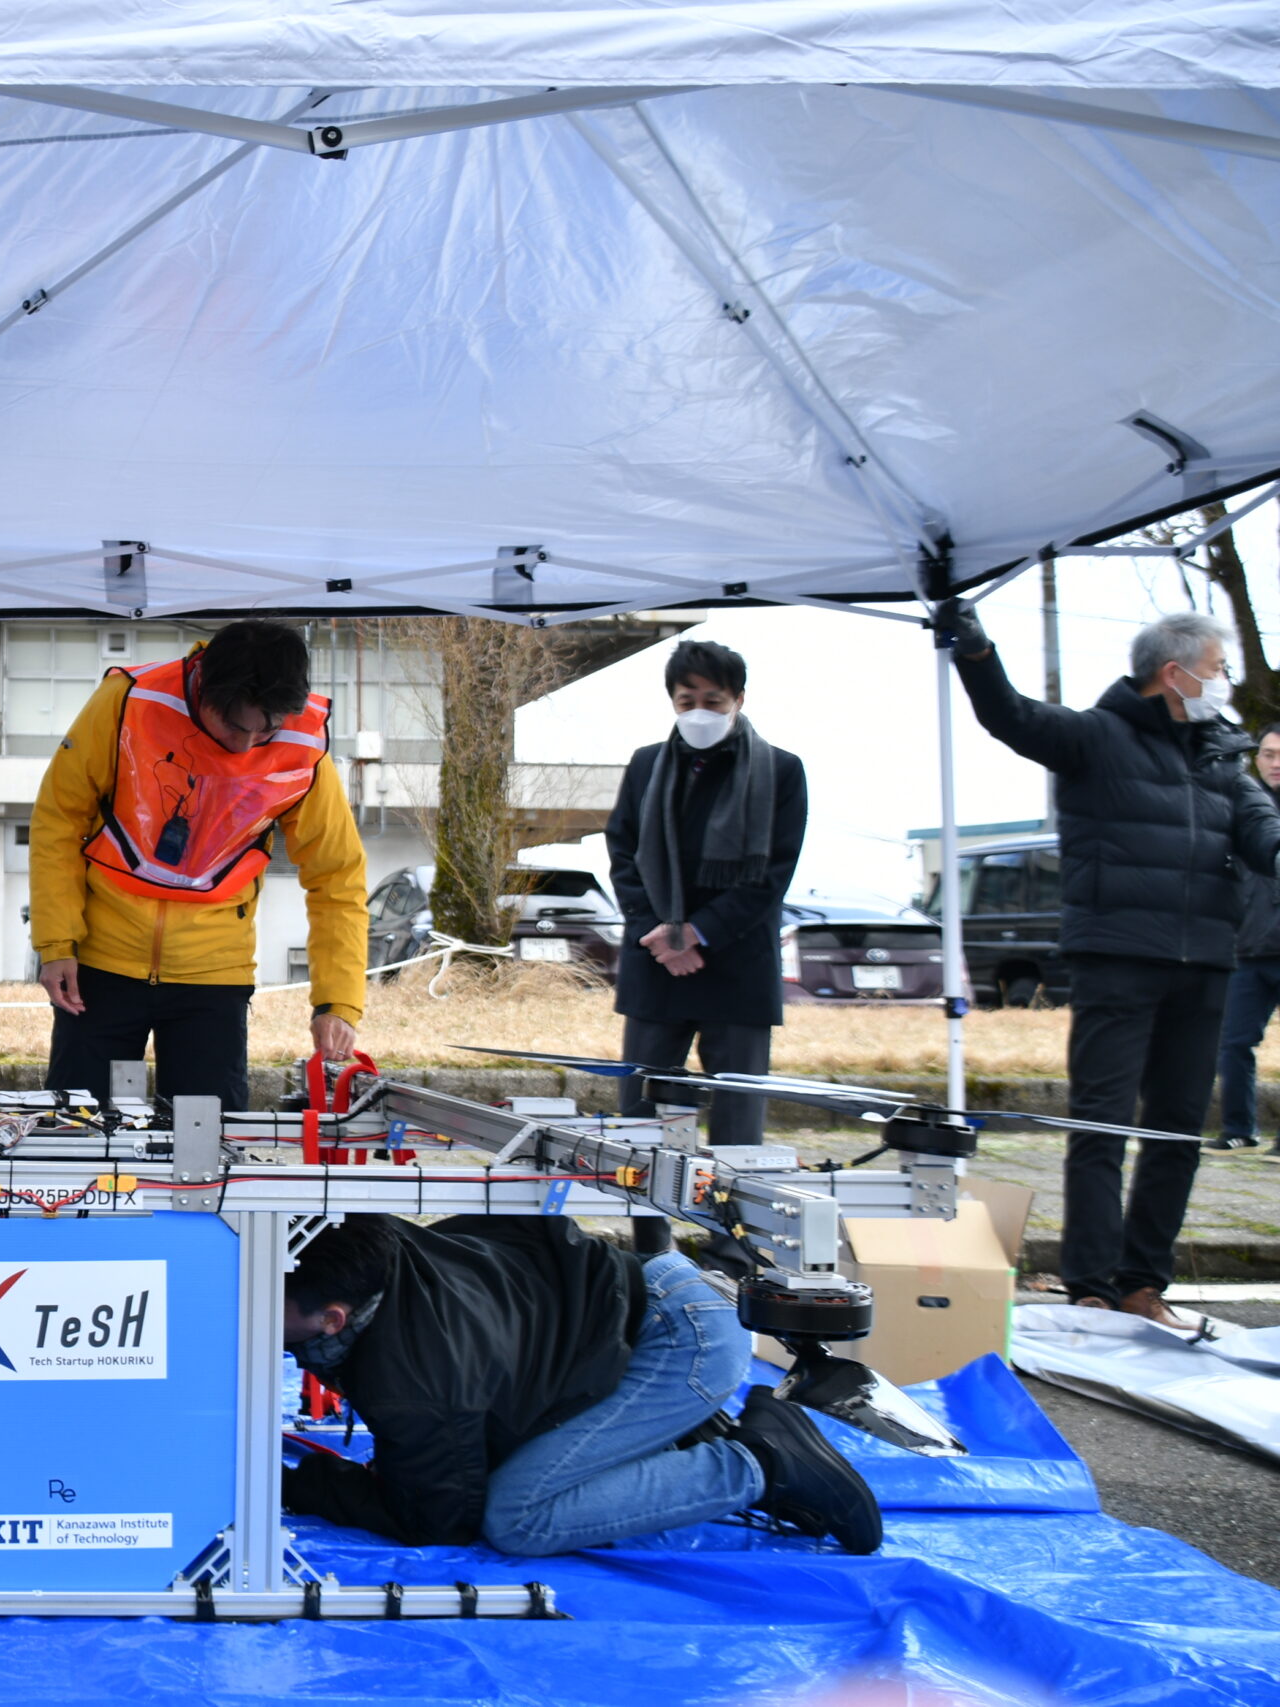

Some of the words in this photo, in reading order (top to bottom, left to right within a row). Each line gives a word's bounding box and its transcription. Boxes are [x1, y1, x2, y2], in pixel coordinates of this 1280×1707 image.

[34, 1289, 150, 1349] TeSH
[29, 1356, 53, 1366] Tech
[55, 1356, 94, 1368] Startup
[97, 1355, 154, 1366] HOKURIKU
[48, 1478, 77, 1504] Re
[56, 1519, 117, 1530] Kanazawa
[119, 1518, 169, 1530] Institute
[56, 1533, 70, 1544] of
[73, 1533, 139, 1546] Technology
